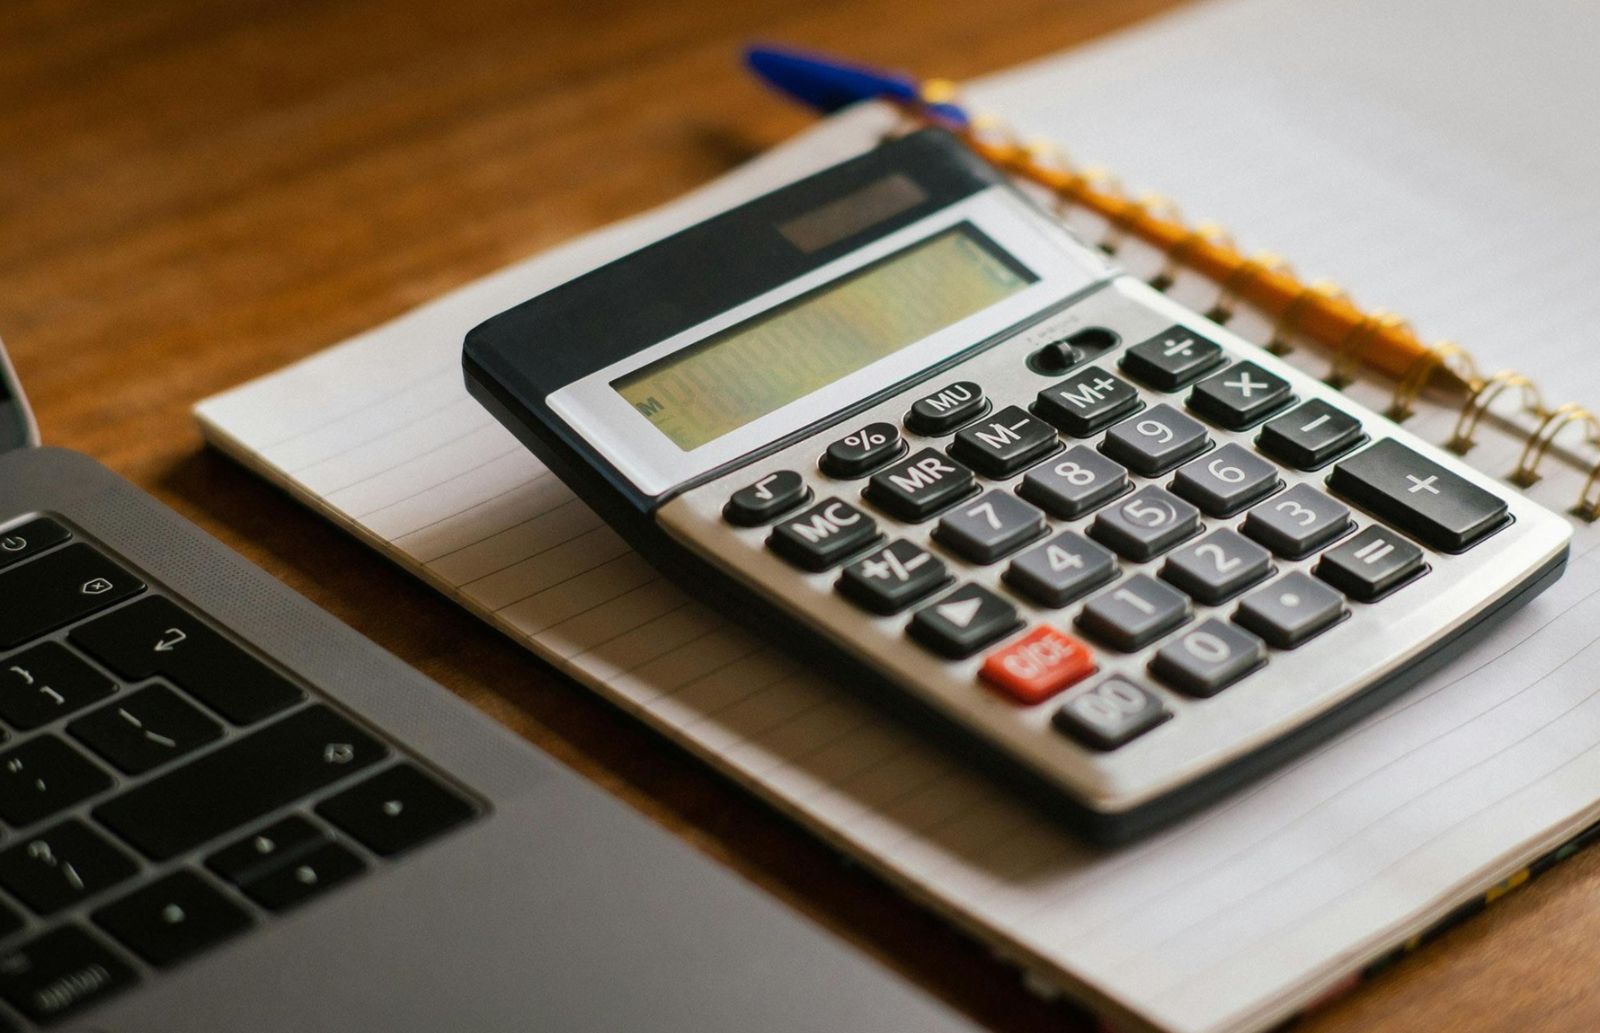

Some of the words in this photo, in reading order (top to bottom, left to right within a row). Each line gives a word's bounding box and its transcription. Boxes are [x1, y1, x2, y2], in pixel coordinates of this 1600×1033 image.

[926, 385, 972, 412] MU
[1060, 376, 1116, 409] M+
[844, 430, 887, 452] %
[1136, 420, 1173, 443] 9
[890, 457, 955, 494] MR
[1054, 461, 1094, 486] 8
[1208, 459, 1246, 483] 6
[796, 504, 860, 542] MC
[967, 503, 1004, 530] 7
[1126, 500, 1166, 528] 5
[1276, 501, 1317, 526] 3
[1047, 544, 1082, 572] 4
[1195, 543, 1241, 574] 2
[1116, 589, 1156, 614] 1
[1184, 632, 1230, 663] 0
